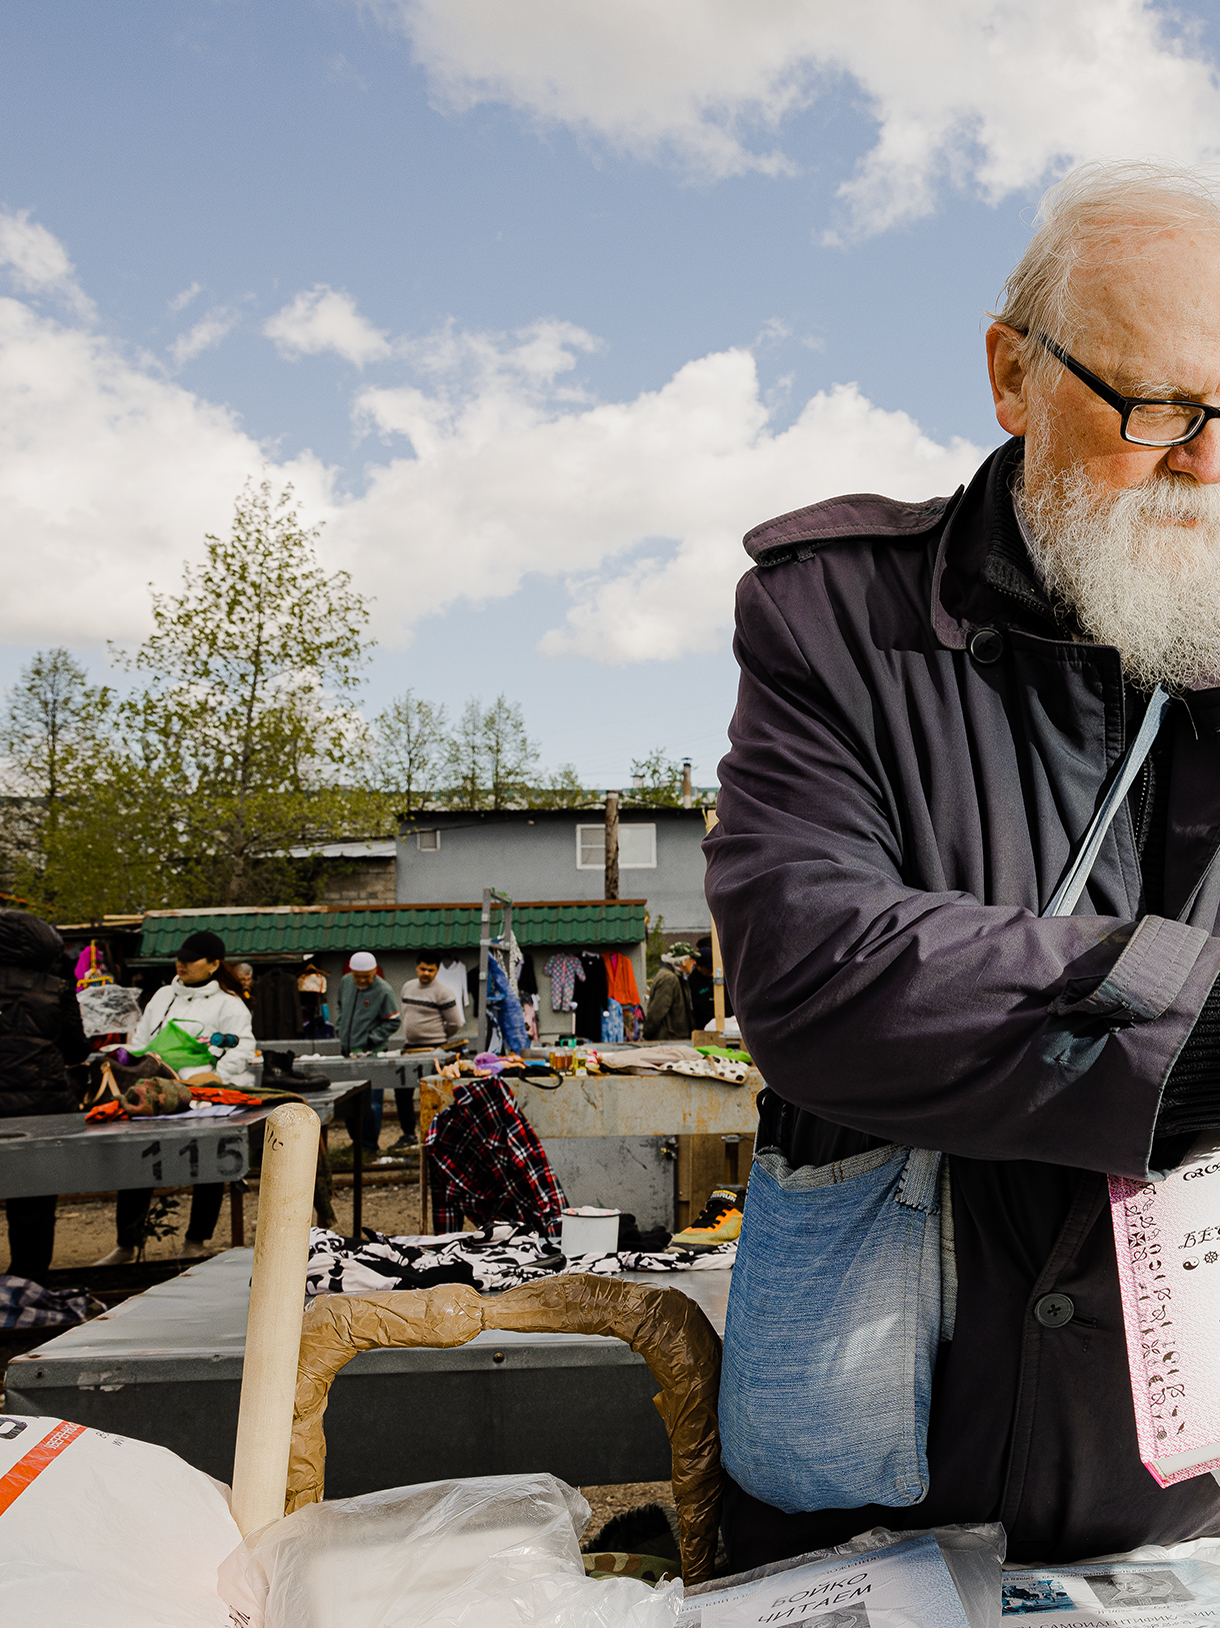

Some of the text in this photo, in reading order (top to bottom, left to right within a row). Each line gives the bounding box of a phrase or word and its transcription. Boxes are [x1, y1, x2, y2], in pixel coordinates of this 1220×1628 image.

[142, 1136, 244, 1181] 115
[757, 1584, 874, 1624] ЧИТАЕМ
[770, 1572, 869, 1609] БОЙКО
